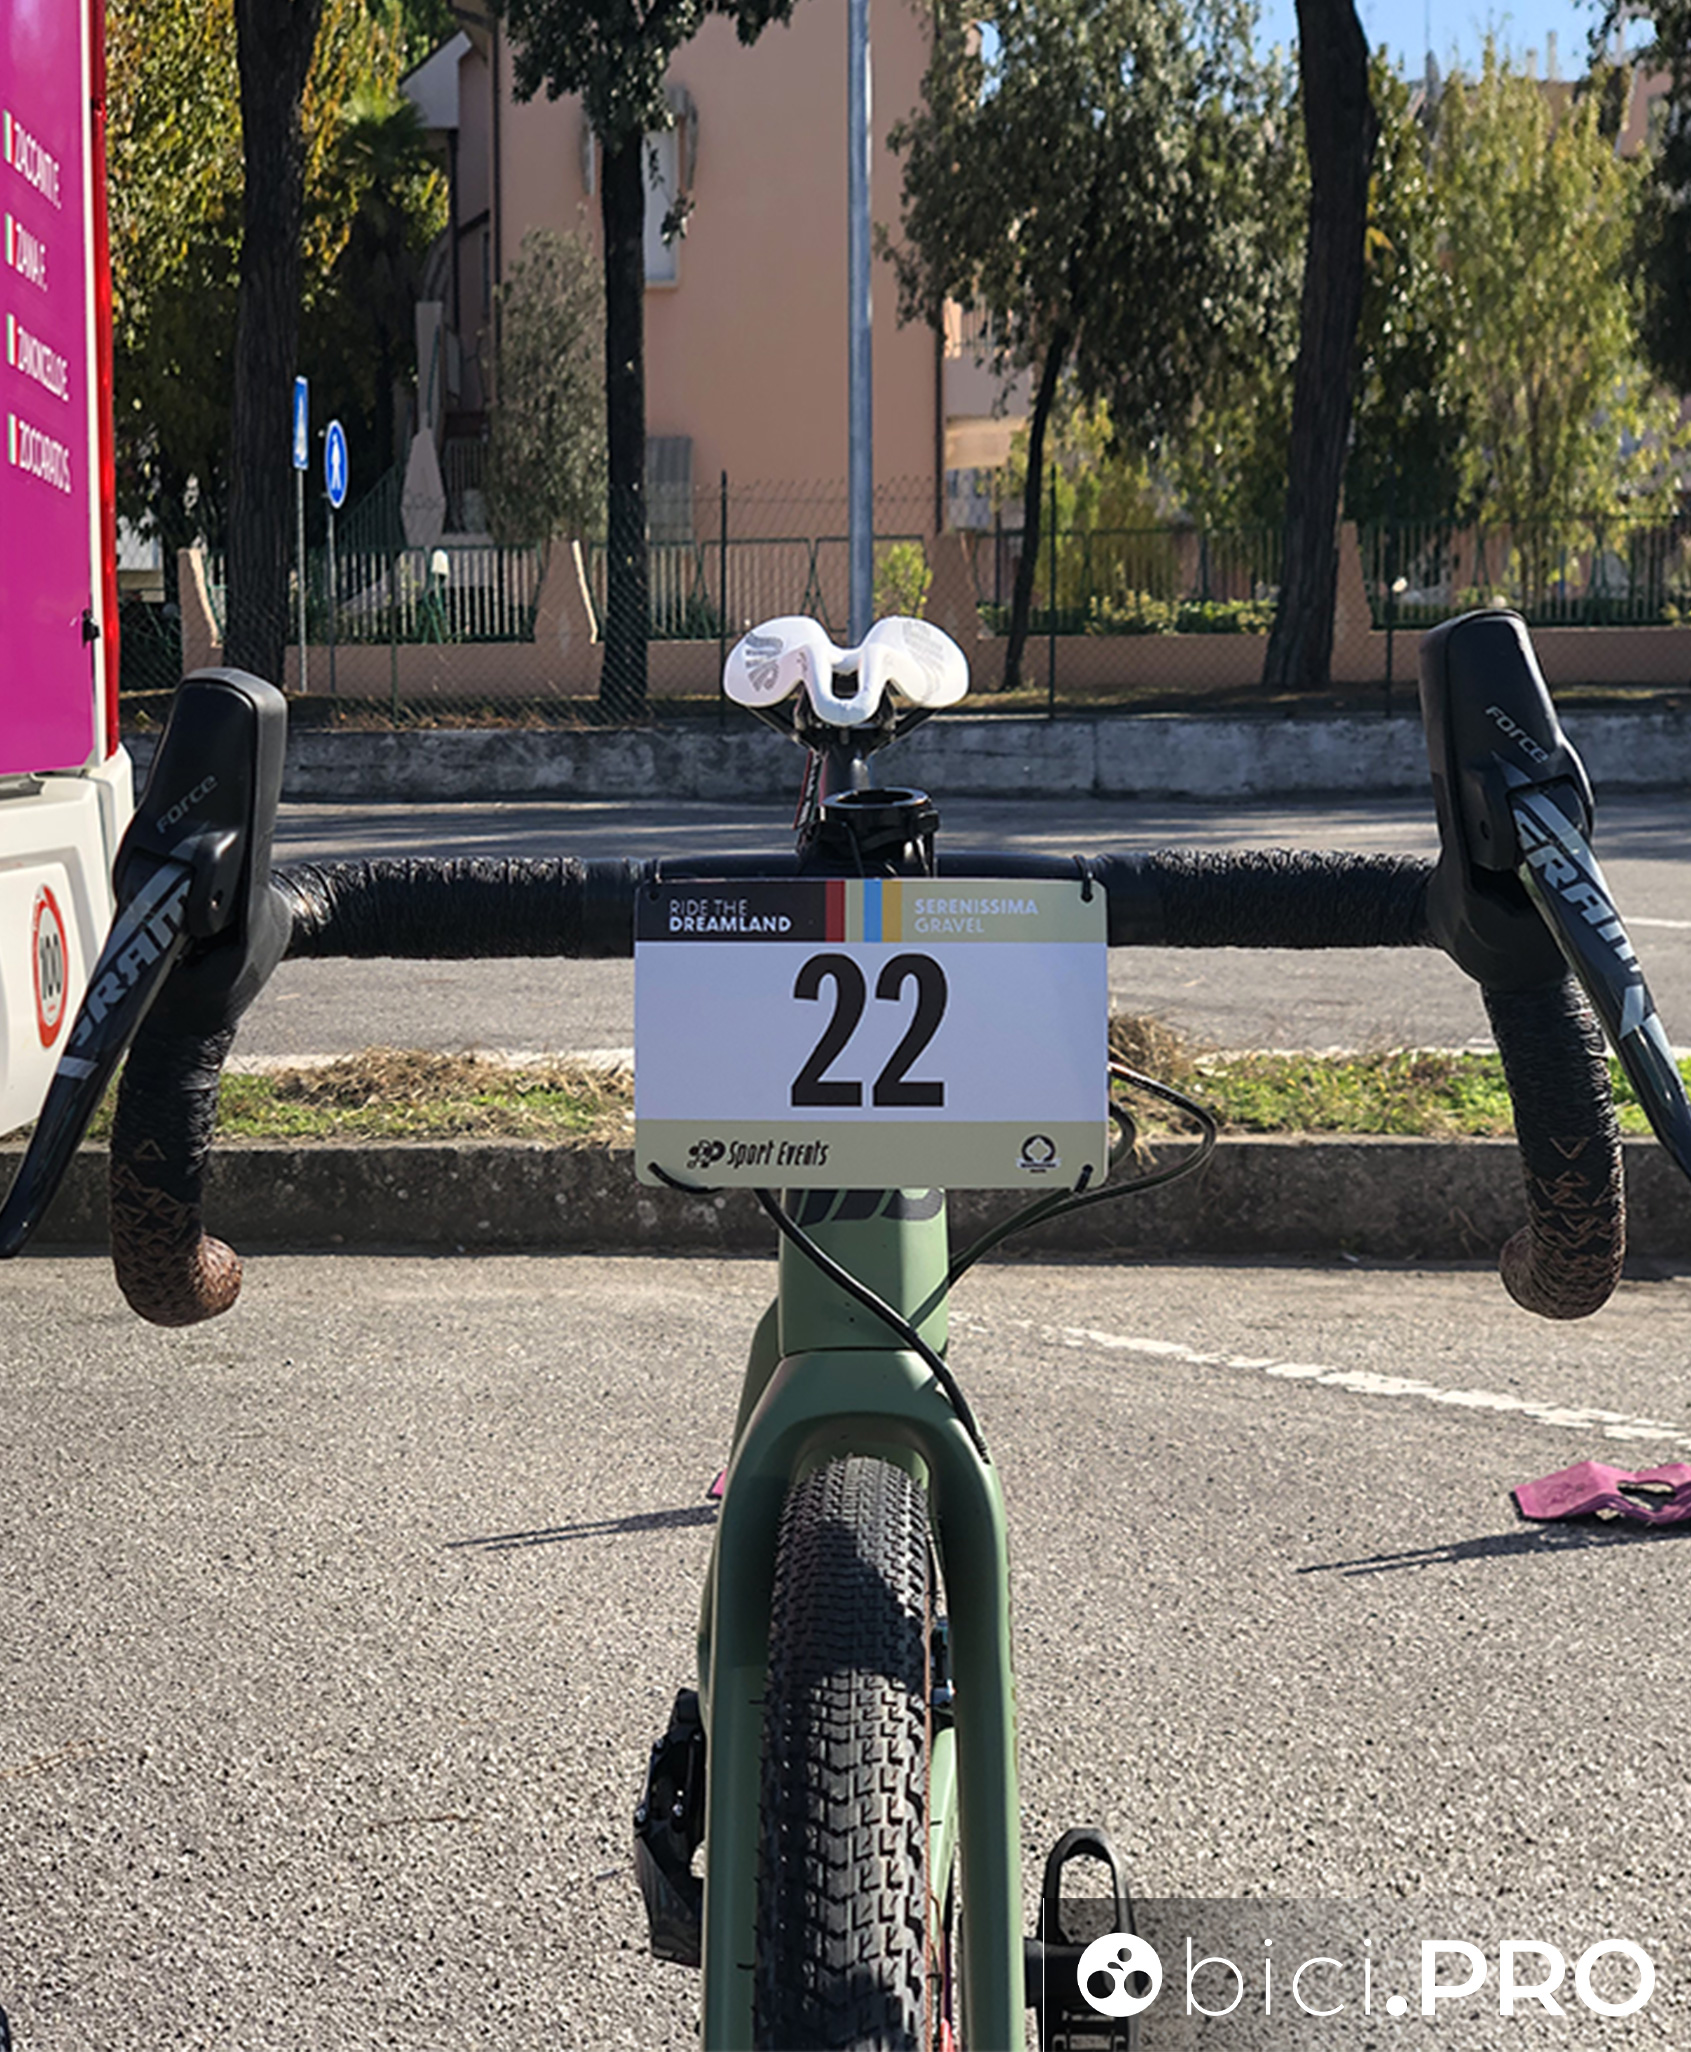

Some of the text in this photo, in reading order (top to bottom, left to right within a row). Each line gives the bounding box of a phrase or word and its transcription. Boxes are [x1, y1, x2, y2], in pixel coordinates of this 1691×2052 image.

[669, 899, 749, 916] RIDE THE
[914, 898, 1039, 915] SERENISSIMA
[668, 916, 792, 932] DREAMLAND
[914, 917, 985, 933] GRAVEL
[39, 932, 63, 1001] 100
[790, 952, 949, 1108] 22
[726, 1140, 774, 1169] Sport
